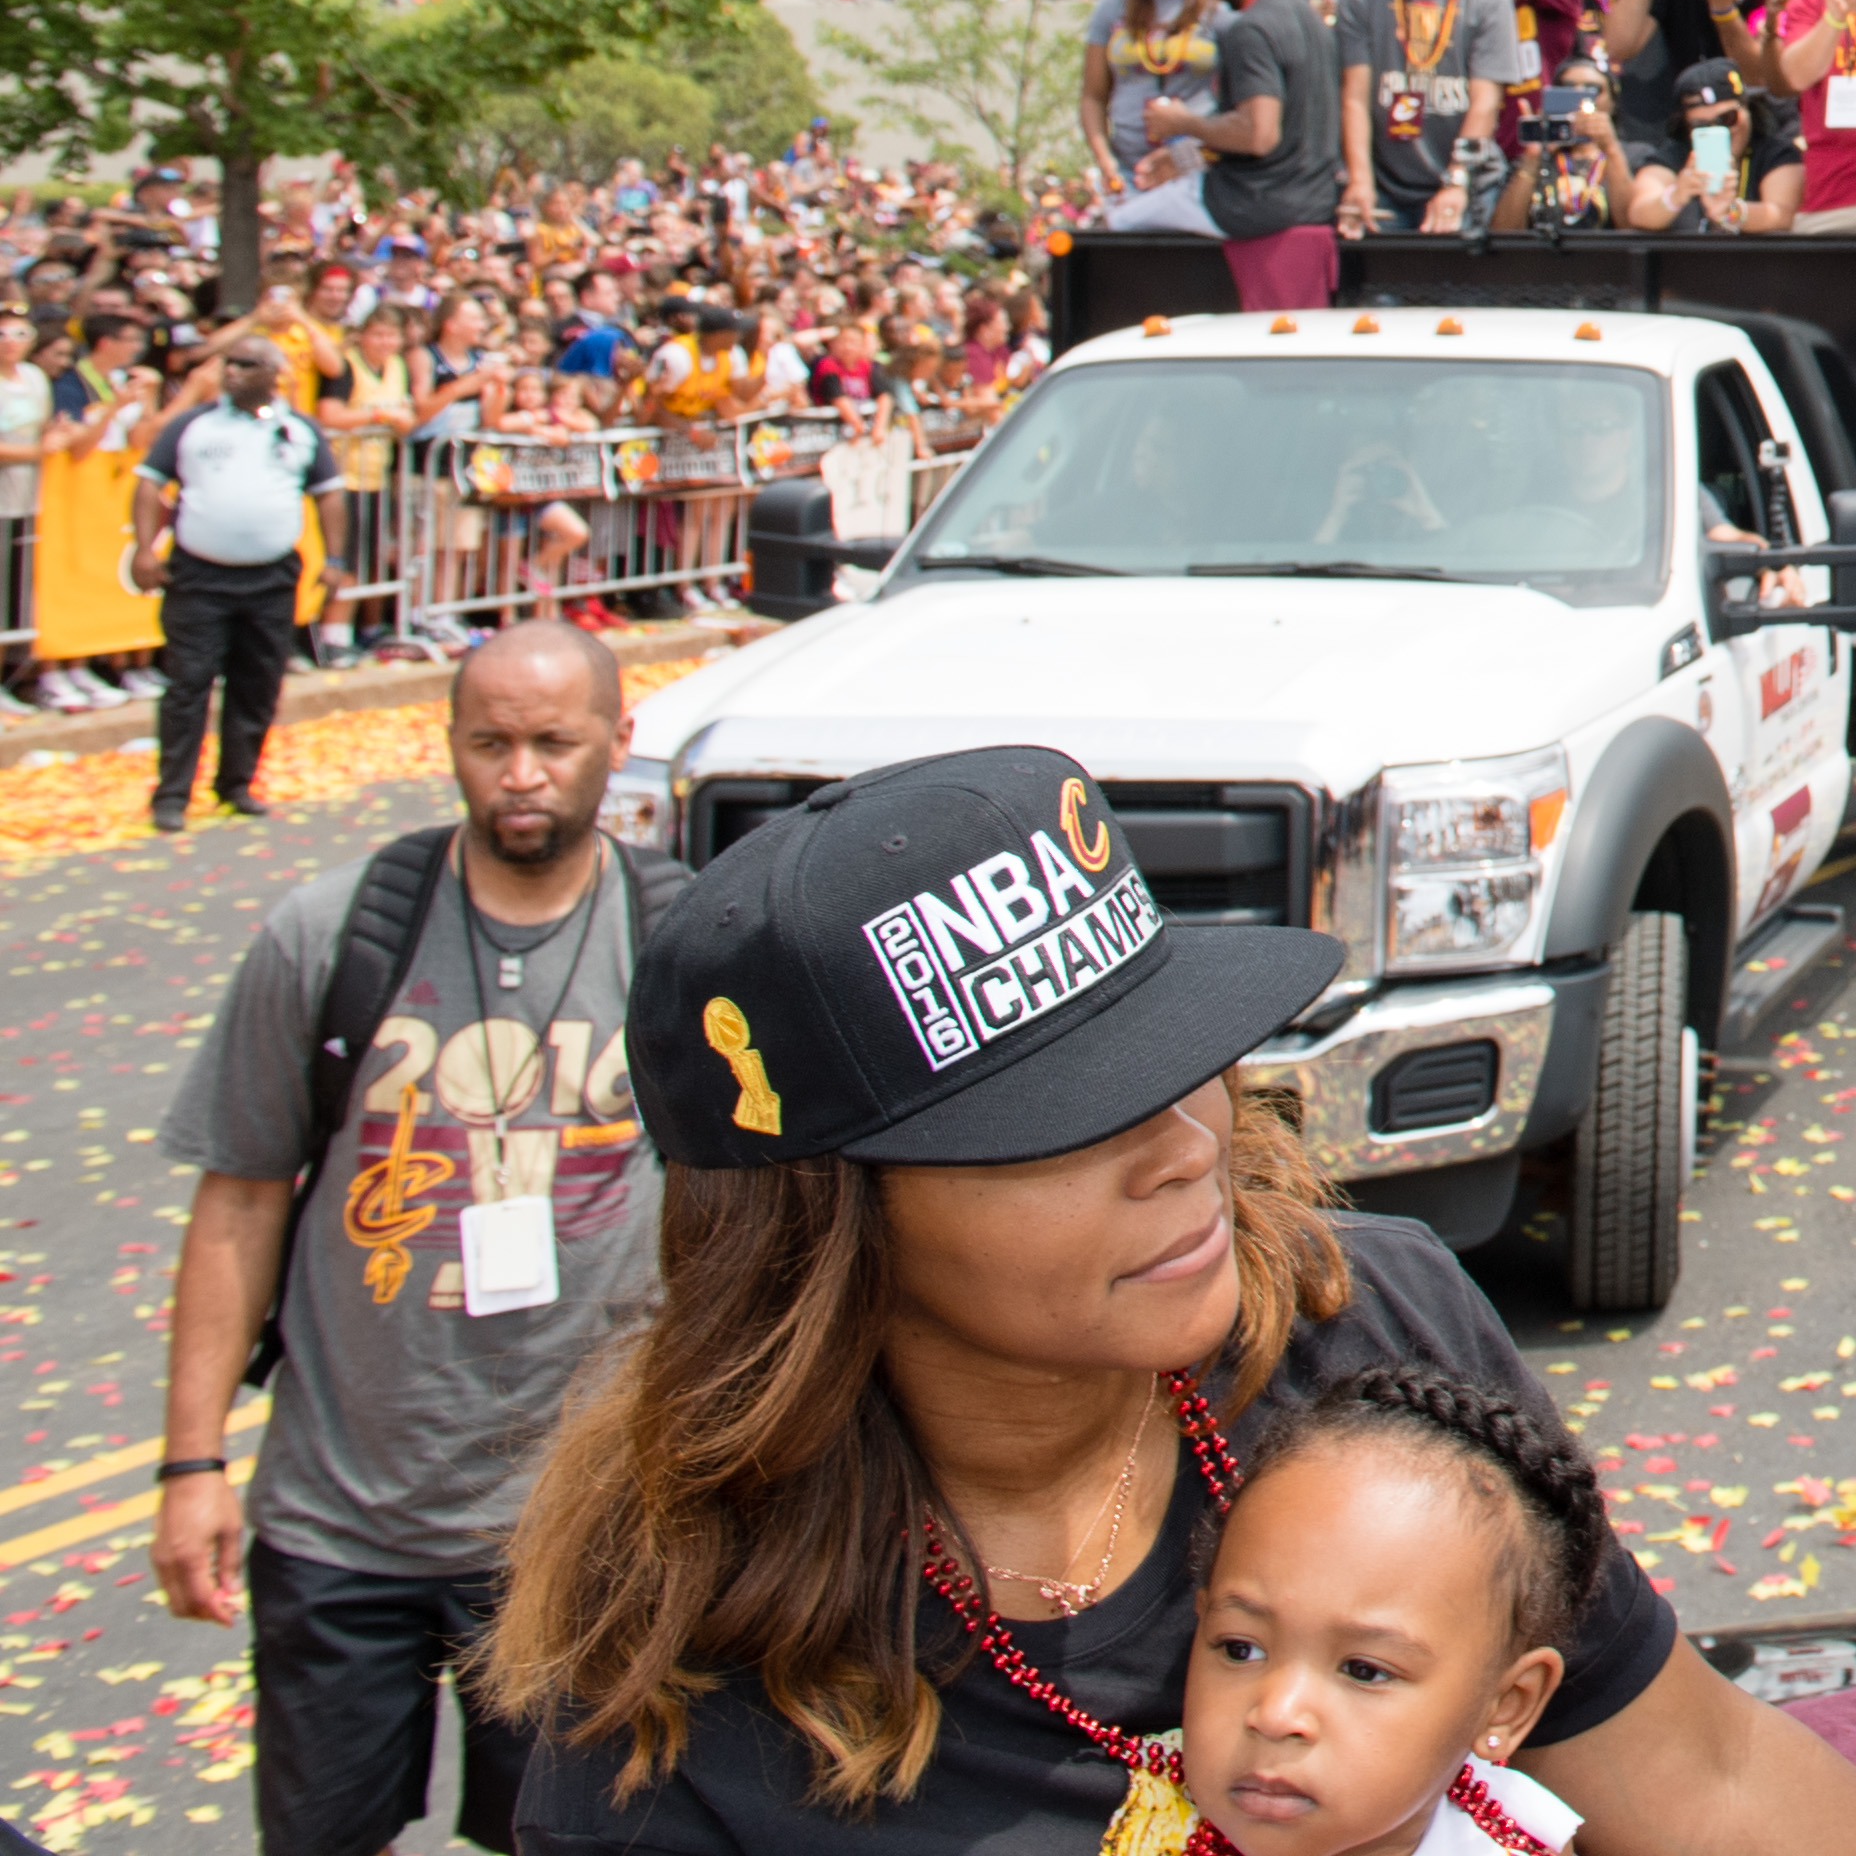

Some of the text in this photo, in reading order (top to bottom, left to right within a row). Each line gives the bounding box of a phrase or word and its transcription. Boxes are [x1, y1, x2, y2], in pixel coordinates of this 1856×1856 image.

[912, 829, 1096, 973] NBA
[969, 872, 1161, 1033] CHAMPS
[877, 915, 967, 1058] 2016
